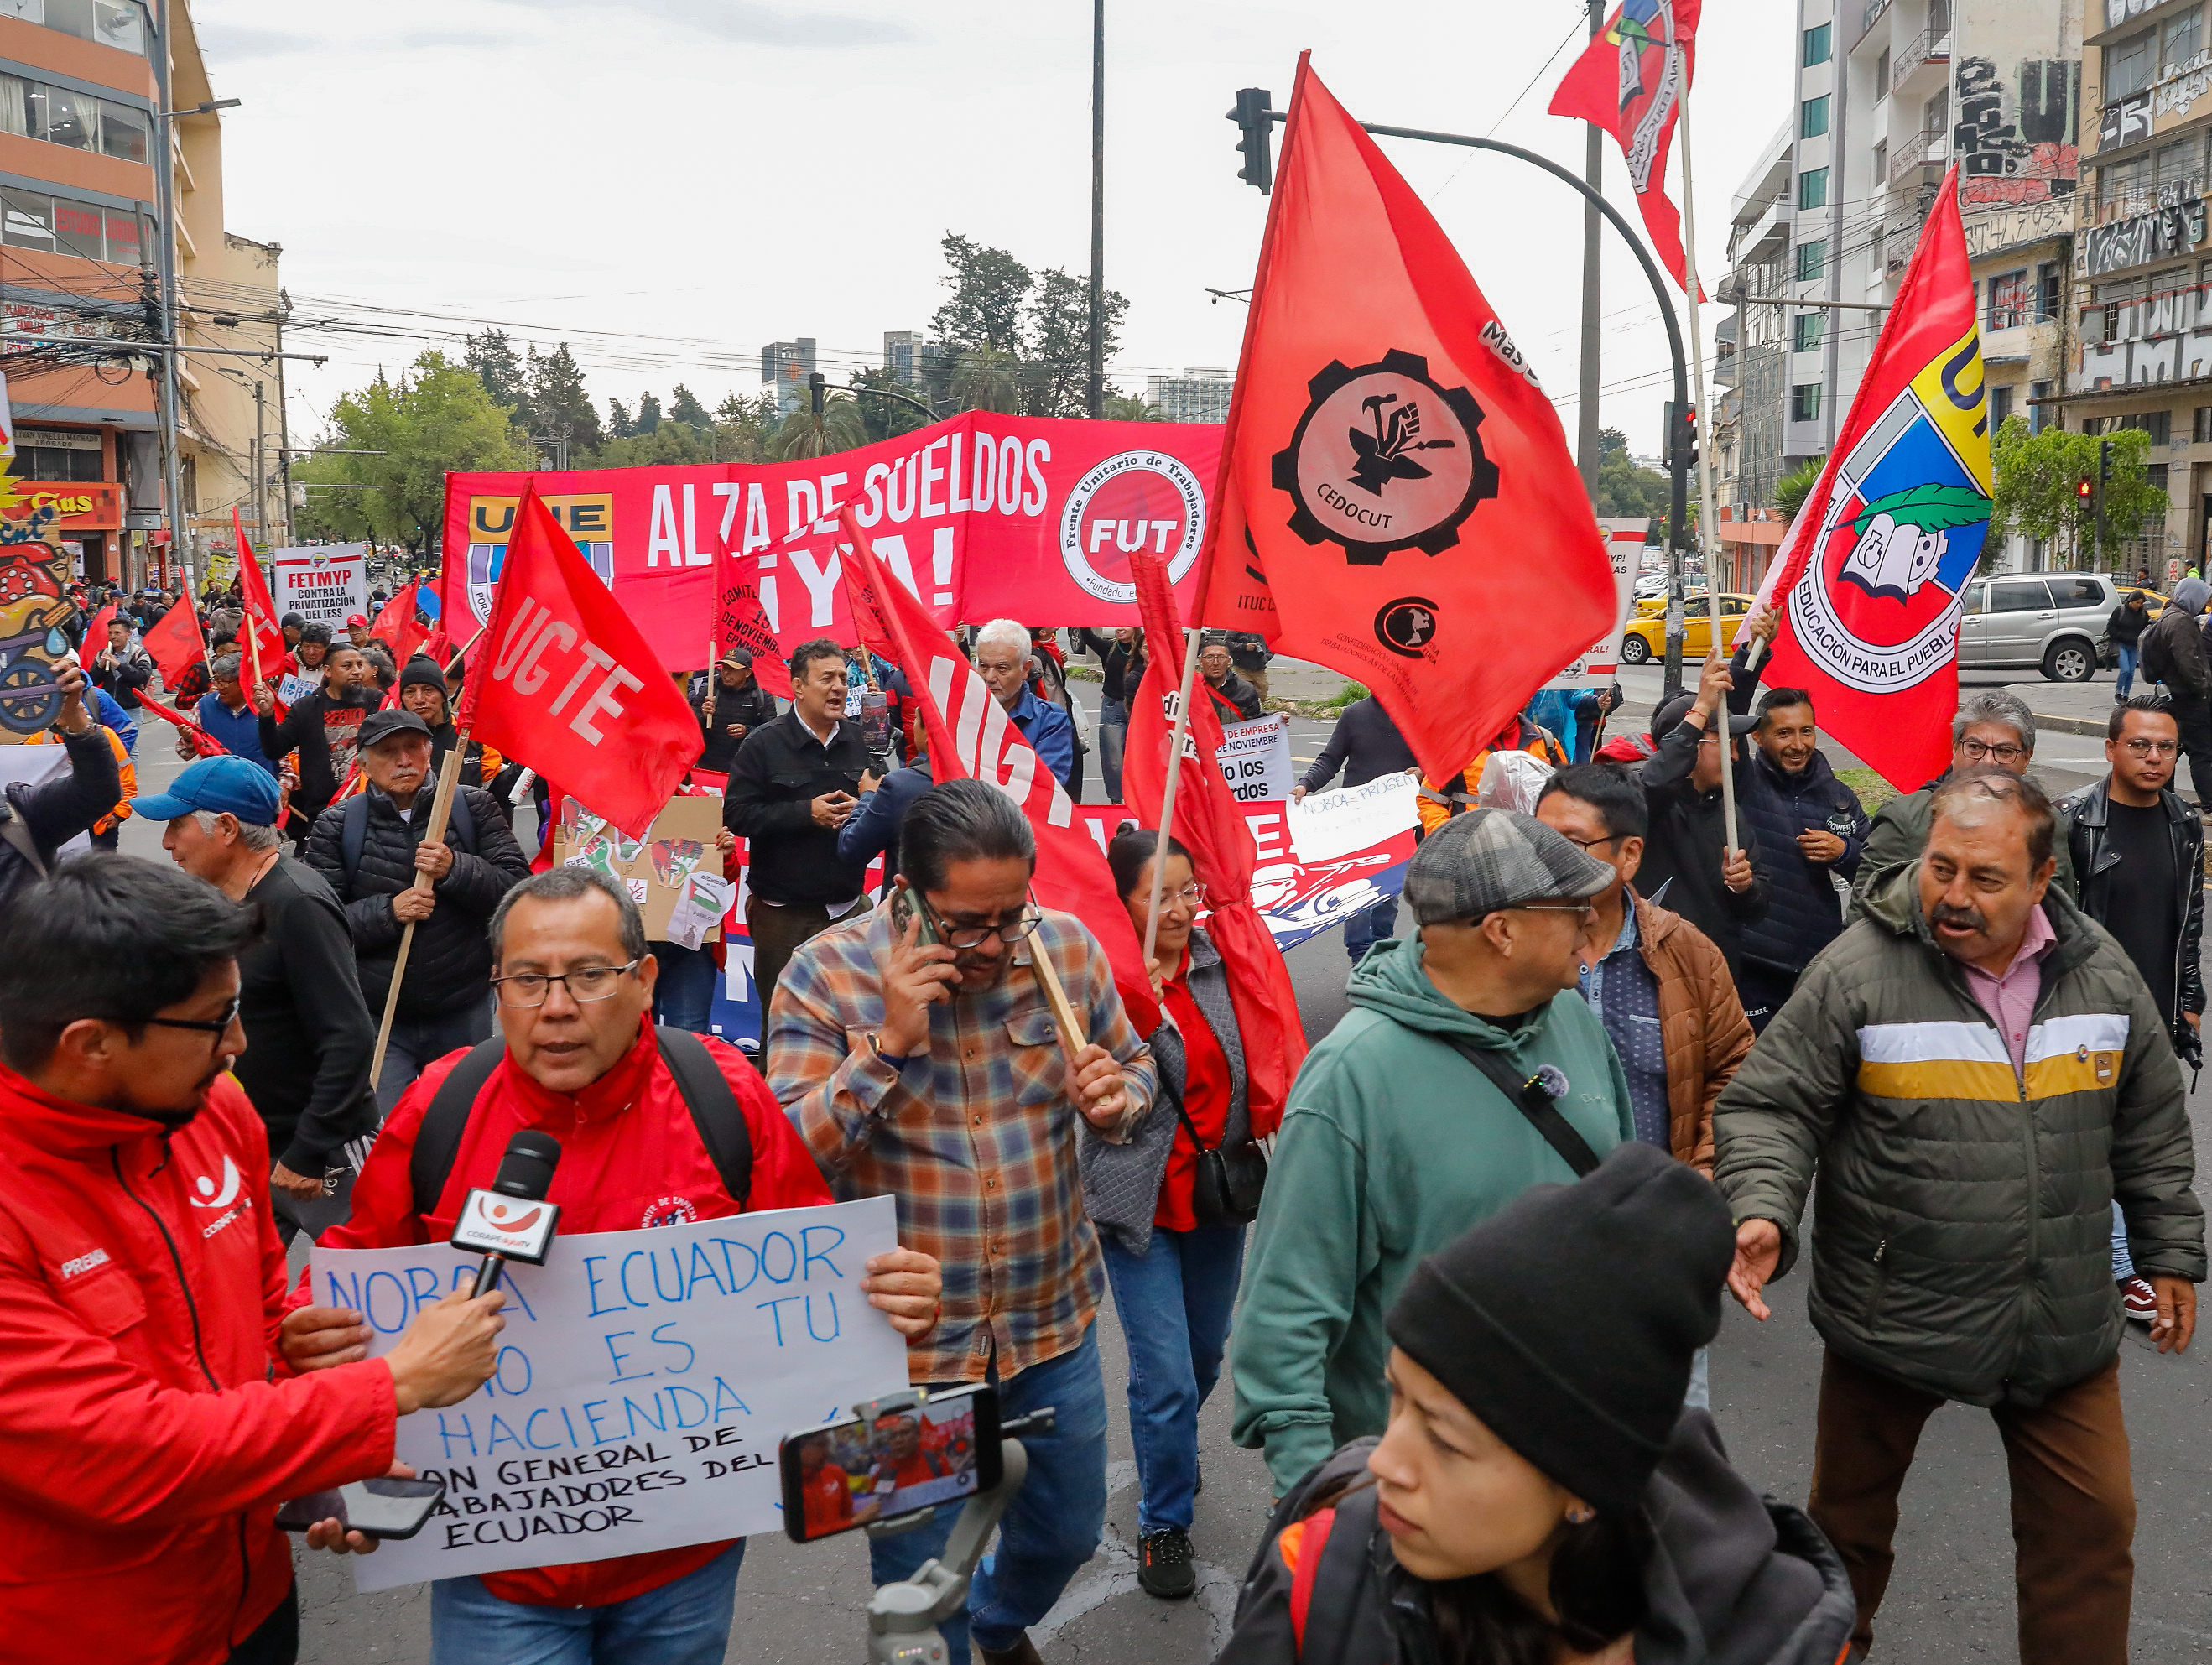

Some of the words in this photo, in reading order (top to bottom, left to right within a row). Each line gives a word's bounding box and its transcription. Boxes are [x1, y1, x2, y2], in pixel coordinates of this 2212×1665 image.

[56, 207, 100, 237] ESTUDIO
[67, 434, 98, 443] MACHADO
[31, 492, 93, 513] Gus
[647, 481, 771, 567] ALZA
[786, 471, 849, 544] DE
[855, 431, 1052, 528] SUELDOS
[1066, 499, 1083, 549] Frente
[1080, 456, 1138, 494] Unitario
[1146, 455, 1163, 467] de
[1168, 463, 1200, 550] Trabajadores
[1316, 482, 1393, 529] CEDOCUT
[1089, 519, 1178, 553] FUT
[288, 570, 351, 588] FETMYP
[1087, 578, 1123, 598] Fundado
[298, 588, 335, 599] CONTRA
[336, 586, 346, 596] LA
[476, 591, 486, 611] POR
[289, 596, 356, 611] PRIVATIZACIÓN
[1238, 595, 1267, 611] ITUC
[305, 610, 322, 620] DEL
[324, 608, 342, 619] IESS
[721, 611, 736, 627] DE
[1798, 580, 1852, 667] EDUCACIÓN
[1851, 655, 1887, 678] PARA
[1890, 661, 1906, 678] EL
[1585, 645, 1610, 653] RAL!
[492, 596, 645, 747] UGTE
[292, 677, 314, 689] FUERA
[849, 686, 867, 695] UERA
[1227, 729, 1239, 739] DE
[1241, 723, 1280, 737] EMPRESA
[1229, 734, 1278, 752] NOVIEMBRE
[1239, 759, 1265, 778] los
[566, 857, 586, 867] FREE
[641, 1204, 658, 1228] OMITE
[658, 1197, 670, 1207] DE
[583, 1225, 845, 1318] ECUADOR
[481, 1345, 532, 1397] O
[605, 1322, 695, 1385] ES
[756, 1291, 840, 1346] TU
[438, 1376, 752, 1459] HACIENDA
[497, 1442, 671, 1485] GENERAL
[682, 1426, 743, 1453] DE
[428, 1470, 687, 1520] ABAJADORES
[701, 1452, 774, 1480] DEL
[441, 1505, 643, 1551] ECUADOR
